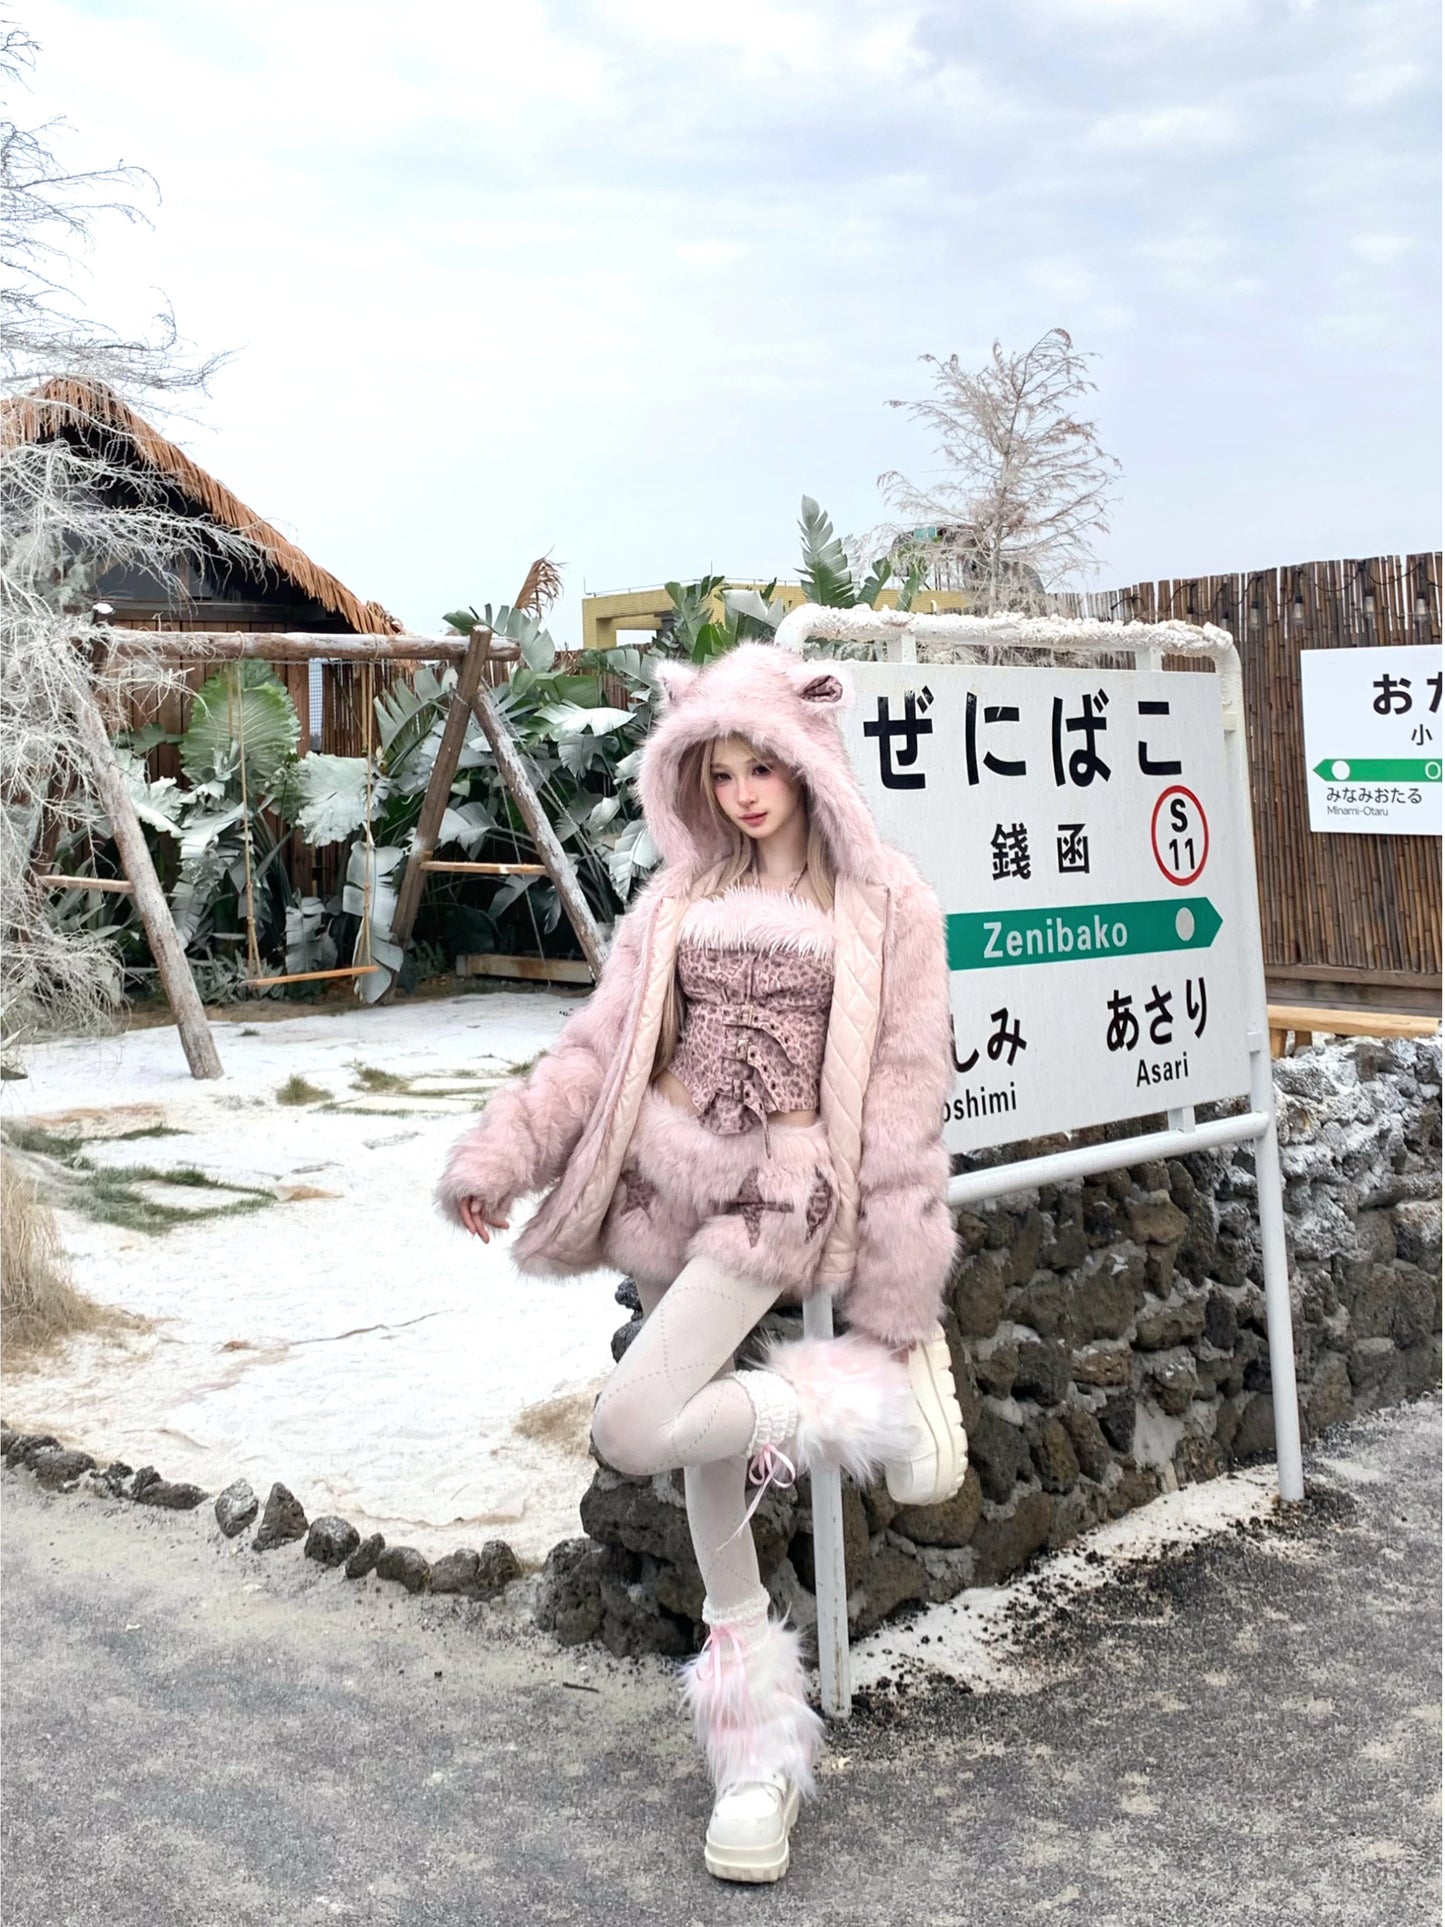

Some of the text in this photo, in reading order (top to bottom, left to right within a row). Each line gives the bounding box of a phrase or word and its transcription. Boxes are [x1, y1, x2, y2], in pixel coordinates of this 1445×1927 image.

[863, 685, 1182, 790] ぜにばこ
[1411, 723, 1433, 746] 小
[1326, 787, 1422, 804] みなみおたる
[1327, 805, 1389, 817] Minami-Otaru
[1170, 798, 1189, 833] S
[1169, 838, 1196, 872] 11
[983, 917, 1129, 960] Zenibako
[1106, 976, 1208, 1052] あさり
[1136, 1051, 1189, 1087] Asari
